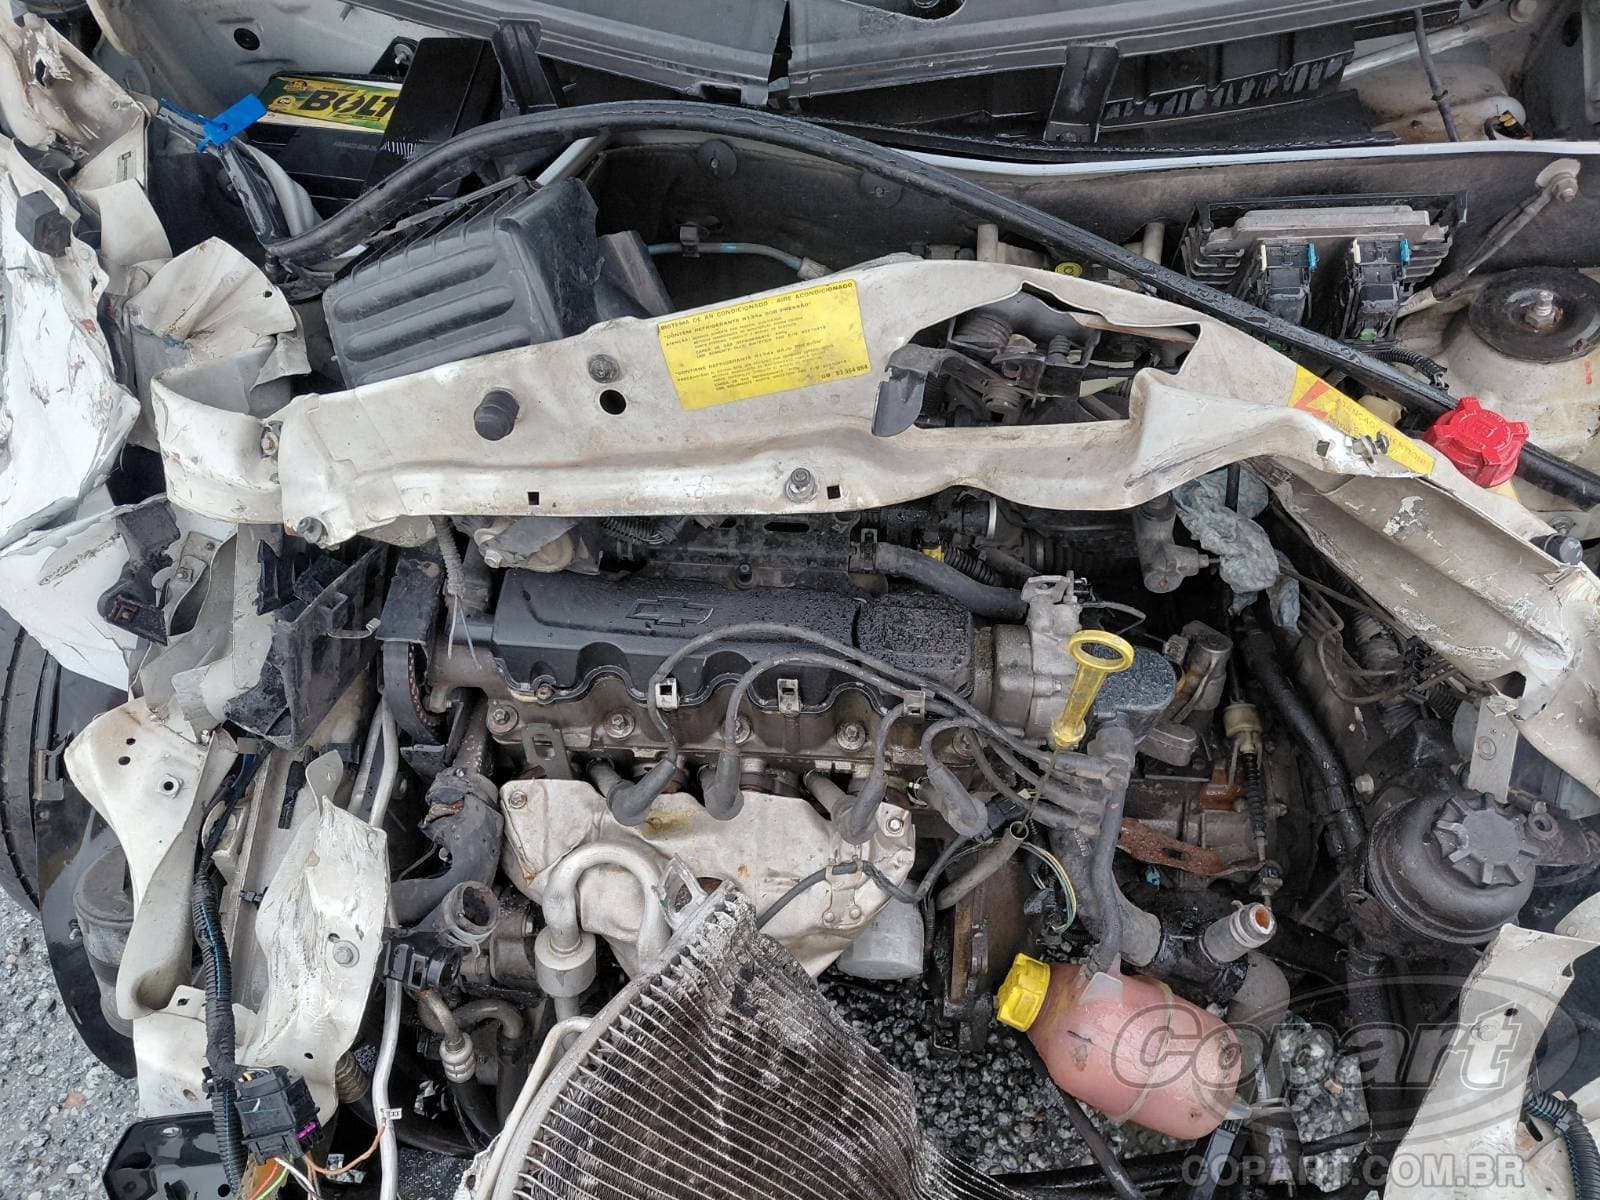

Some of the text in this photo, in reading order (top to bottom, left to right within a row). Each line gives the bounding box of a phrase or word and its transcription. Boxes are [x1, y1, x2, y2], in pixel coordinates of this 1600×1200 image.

[298, 90, 399, 117] BOLT
[715, 301, 768, 317] CONDICIONADO
[775, 295, 791, 303] AIRE
[794, 281, 852, 299] ACONDICIONADO
